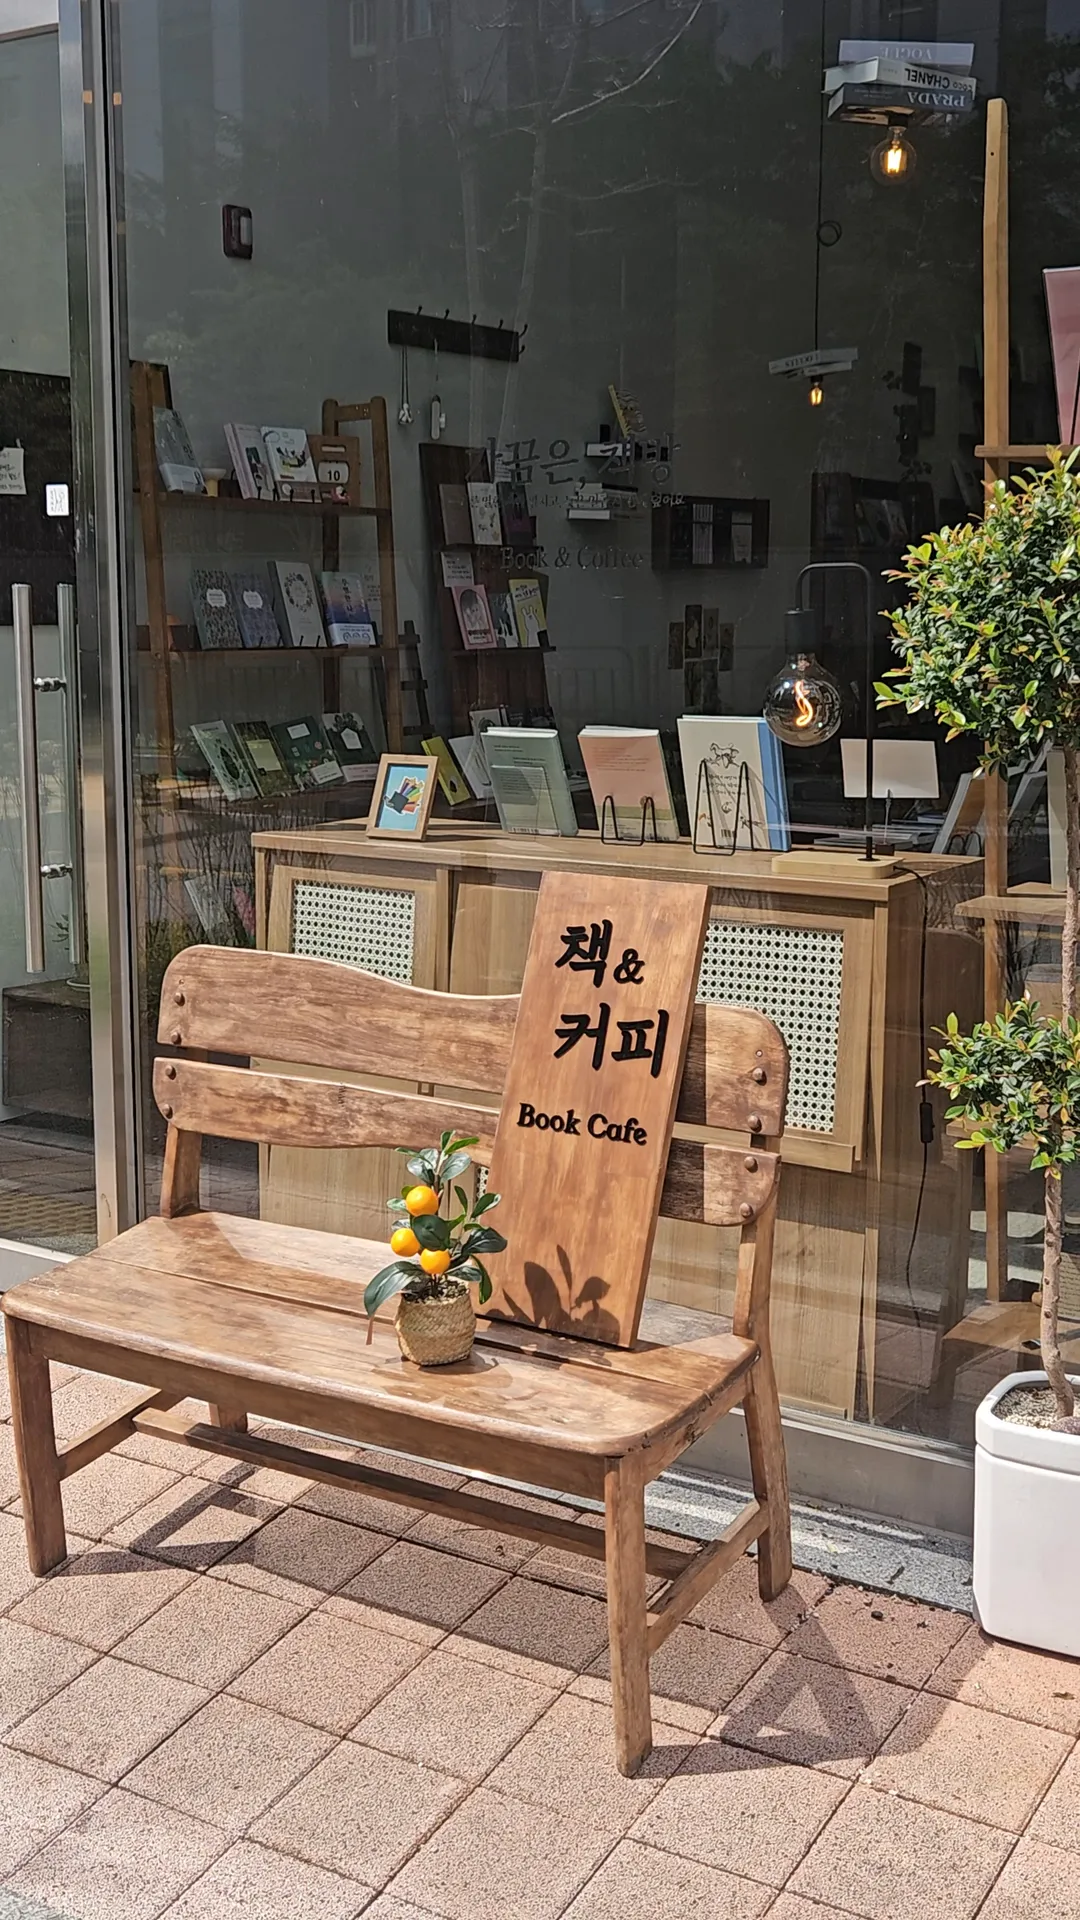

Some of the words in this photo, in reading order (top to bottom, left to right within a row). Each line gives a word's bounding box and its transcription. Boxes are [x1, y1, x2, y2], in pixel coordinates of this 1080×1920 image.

[880, 47, 932, 60] VOGUE
[905, 68, 950, 89] CHANEL
[907, 91, 965, 107] PRADA
[327, 470, 341, 482] 10
[500, 546, 549, 569] Book
[553, 547, 572, 569] &
[577, 546, 644, 569] Coffee
[553, 1002, 670, 1079] 커피
[516, 1102, 581, 1137] Book
[587, 1112, 648, 1146] Cafe
